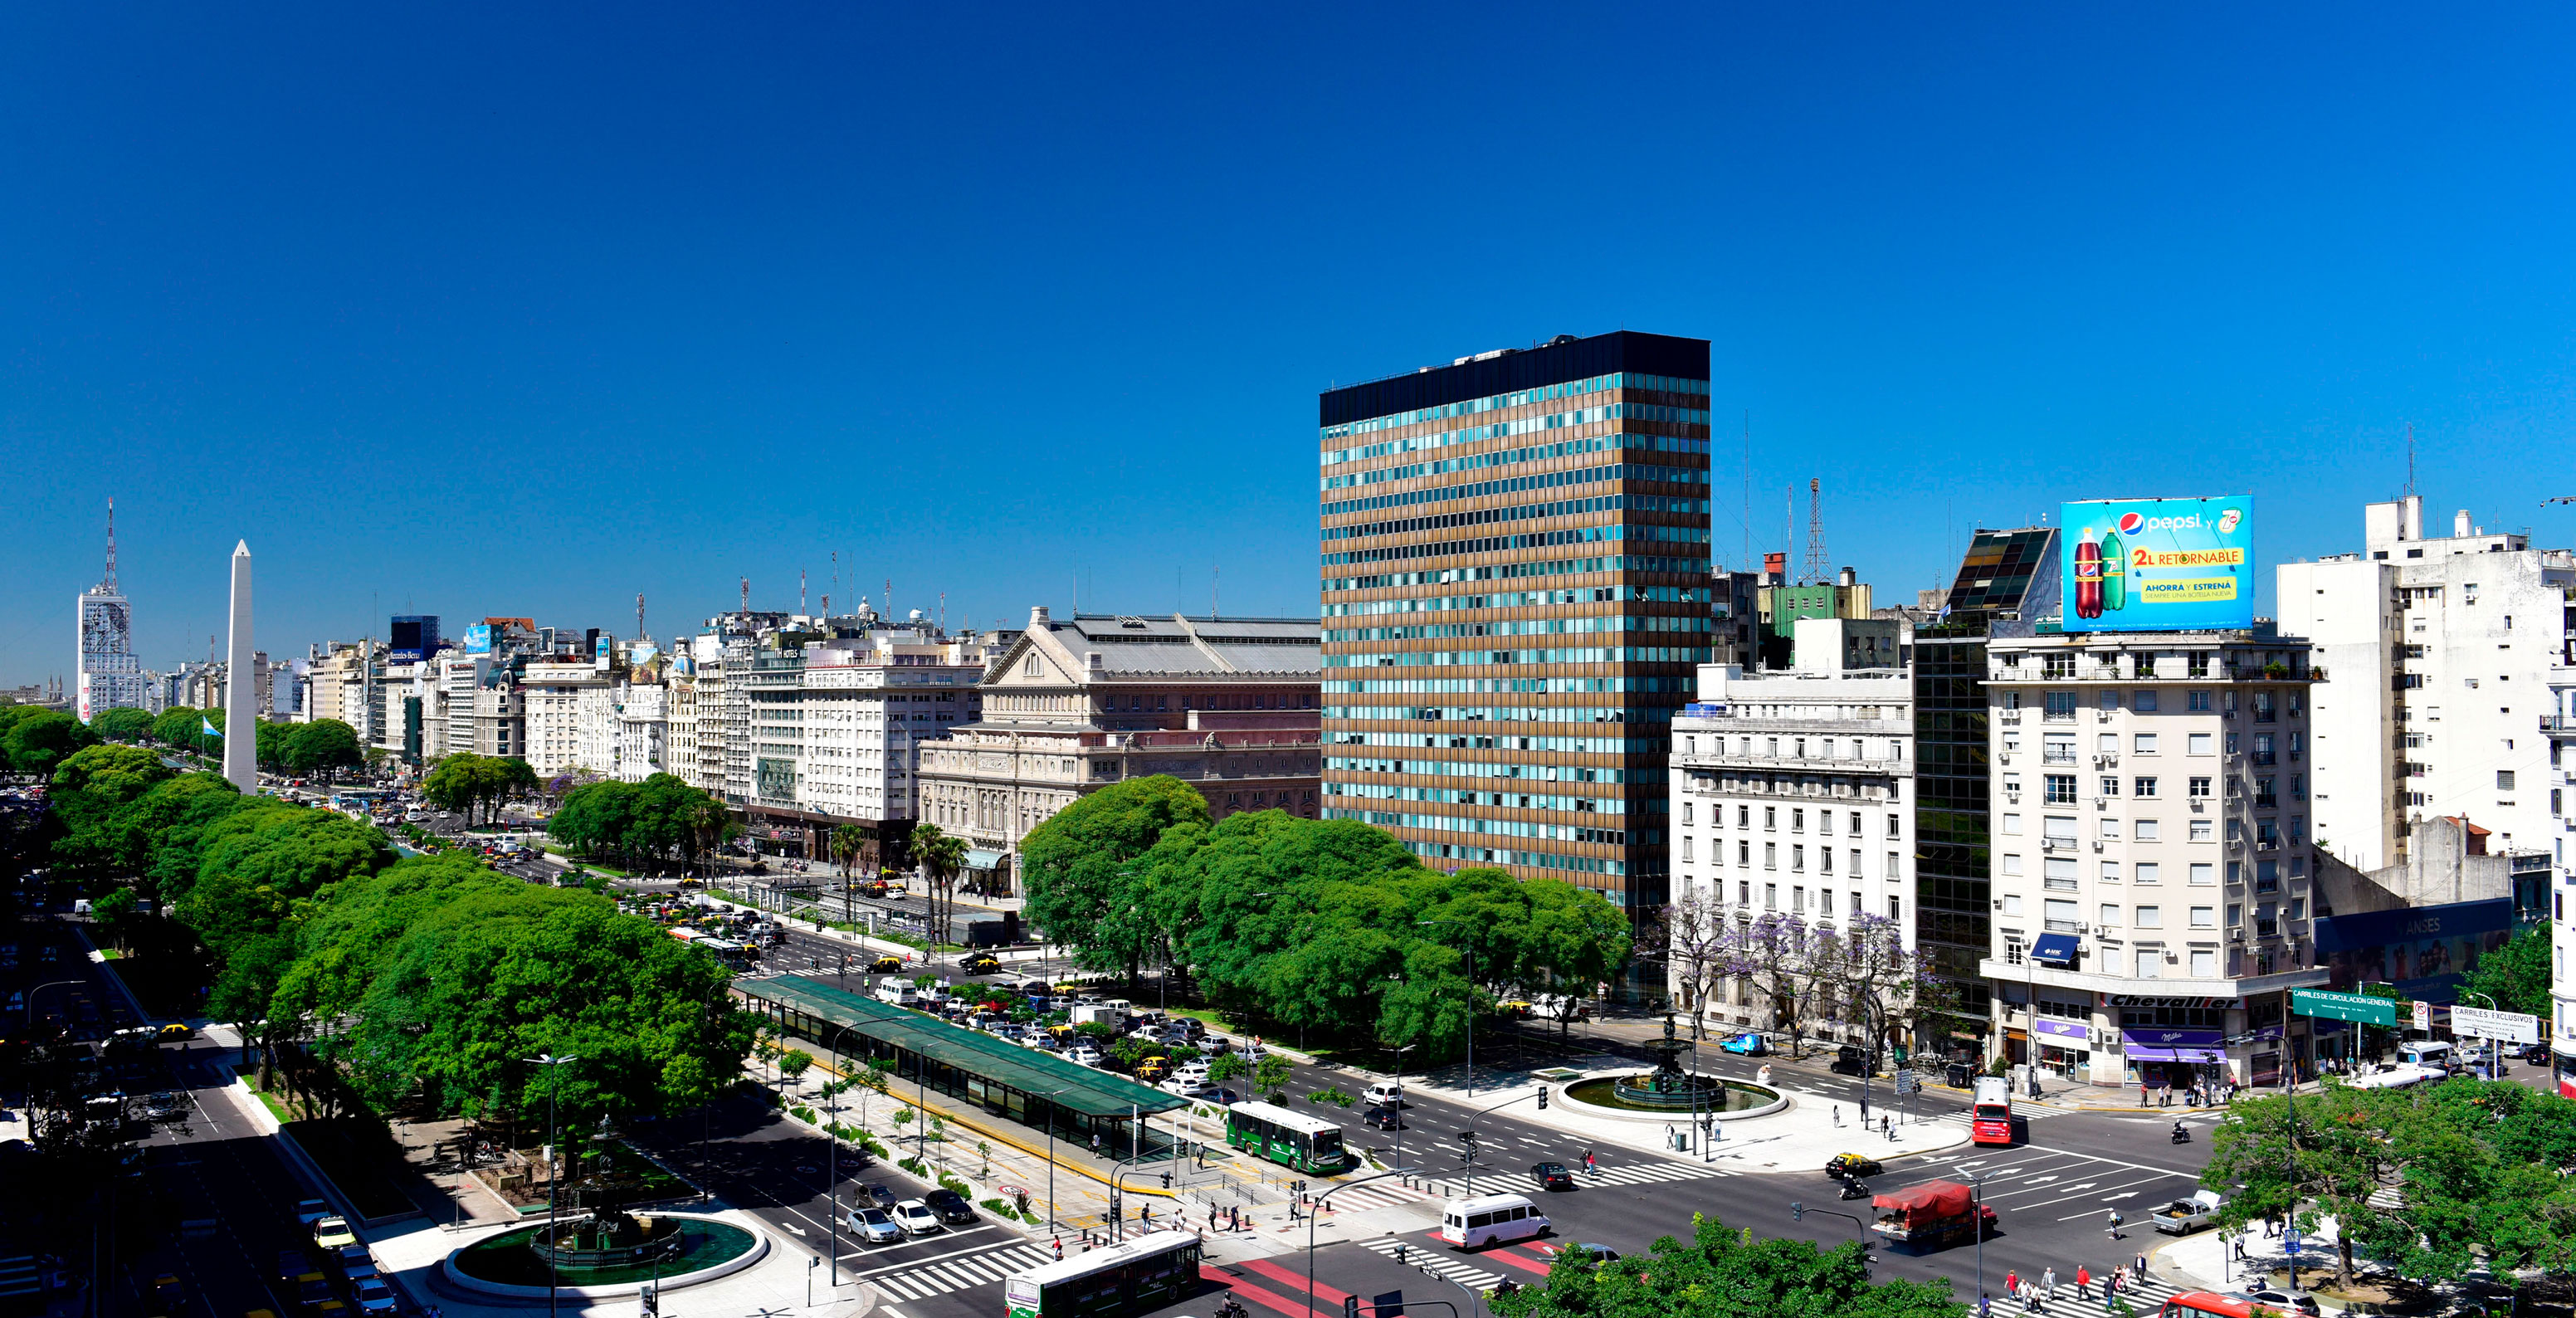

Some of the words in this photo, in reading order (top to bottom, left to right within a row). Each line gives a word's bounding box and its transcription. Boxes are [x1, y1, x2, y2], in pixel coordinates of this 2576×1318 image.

[2148, 513, 2200, 531] pepsi
[2134, 549, 2154, 565] 2L
[2159, 551, 2238, 565] RETORNABLE
[2145, 583, 2184, 592] AHORRÁ
[2193, 580, 2231, 591] ESTRENÁ
[2407, 917, 2441, 935] ANSES
[2110, 994, 2240, 1008] Chevallier
[2293, 990, 2320, 999] CARRILES
[2367, 998, 2394, 1008] GENERAL
[2455, 1008, 2489, 1018] CARRILES
[2492, 1012, 2533, 1023] EXCLUSIVOS
[2054, 1024, 2071, 1034] Milka
[2161, 1032, 2183, 1042] Milka
